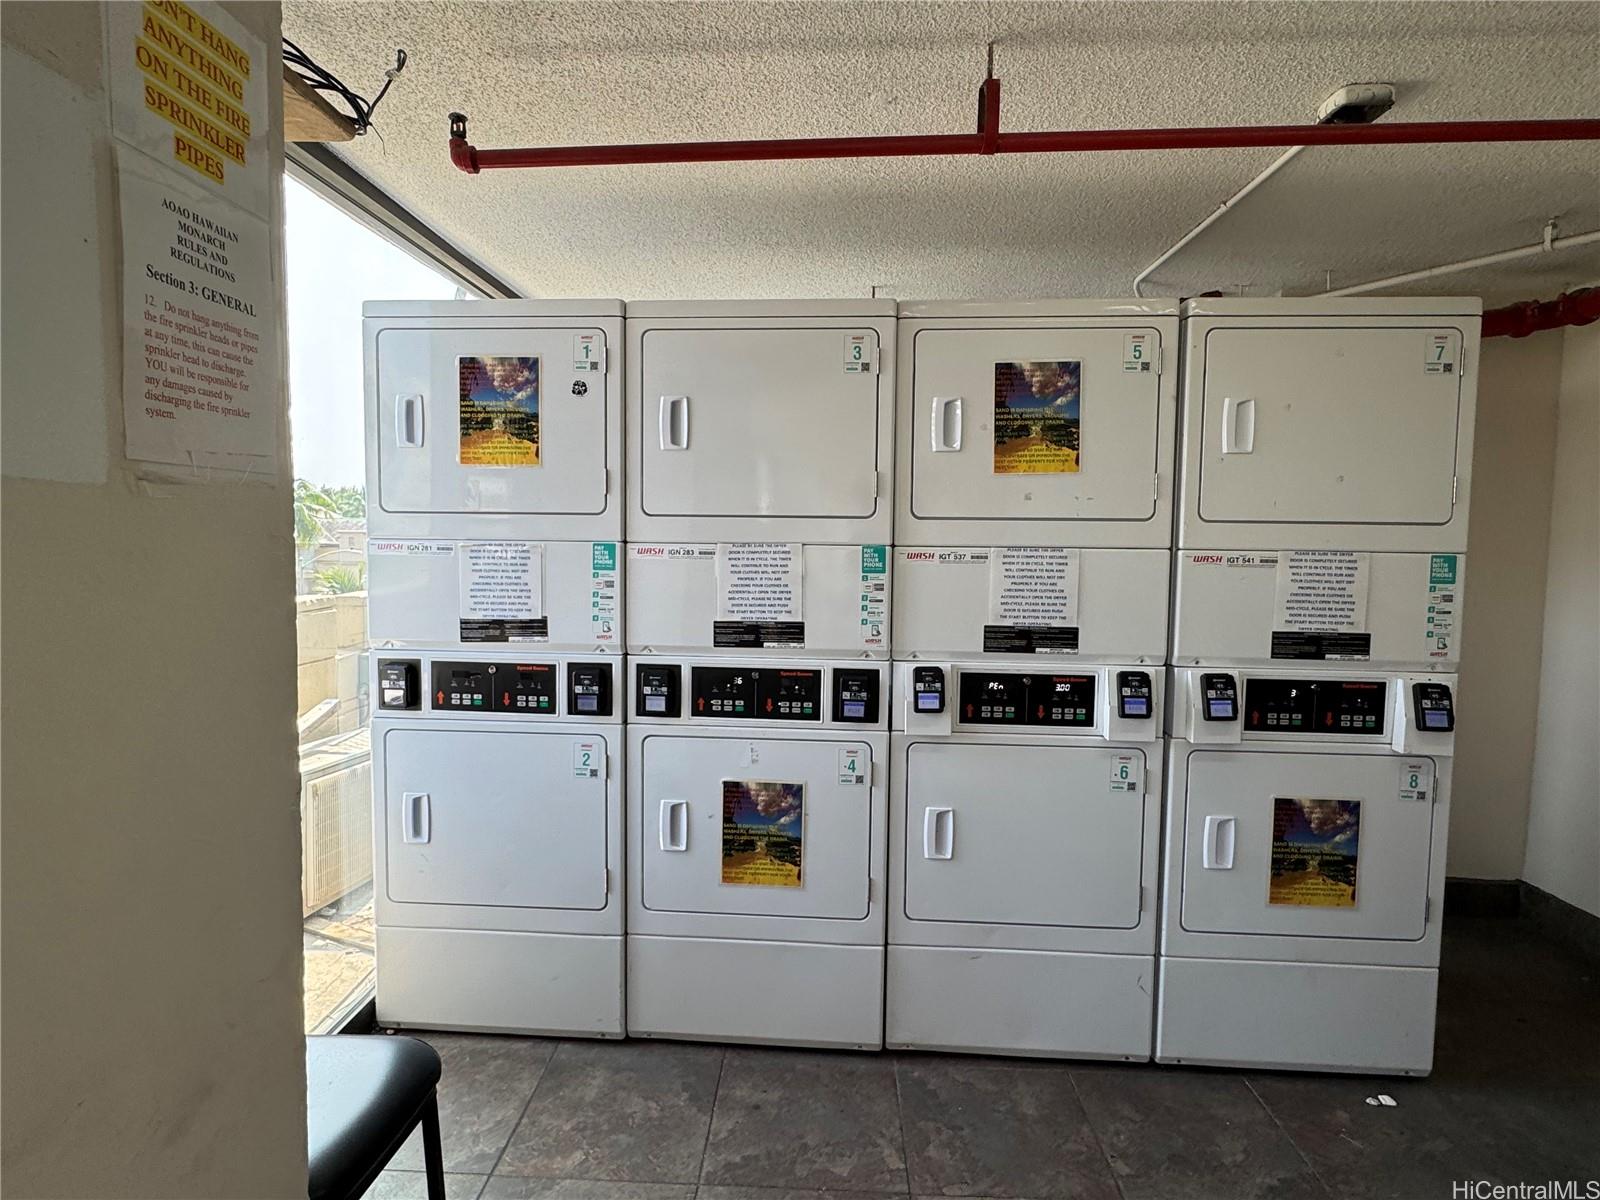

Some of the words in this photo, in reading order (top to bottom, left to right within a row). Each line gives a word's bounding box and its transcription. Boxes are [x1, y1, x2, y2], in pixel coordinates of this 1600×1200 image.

[144, 16, 243, 100] ANYTHING
[200, 23, 250, 75] HANG
[136, 45, 168, 80] ON
[173, 68, 212, 110] THE
[216, 98, 250, 137] FIRE
[145, 85, 246, 163] SPRINKLER
[174, 135, 224, 179] PIPES
[161, 197, 190, 219] AOAO
[192, 212, 239, 243] HAWAIIAN
[178, 220, 226, 251] MONARCH
[176, 235, 208, 257] RULES
[209, 250, 228, 266] AND
[169, 246, 236, 283] REGULATIONS
[146, 263, 186, 292] Section
[188, 281, 198, 297] 3:
[201, 286, 257, 318] GENERAL
[582, 344, 590, 359] 1
[853, 345, 862, 361] 3
[1132, 344, 1142, 360] 5
[1434, 345, 1445, 361] 7
[145, 357, 168, 372] YOU
[637, 547, 665, 555] WASH
[582, 752, 591, 767] 2
[847, 754, 856, 768] 4
[1119, 765, 1129, 780] 6
[1408, 774, 1418, 789] 8
